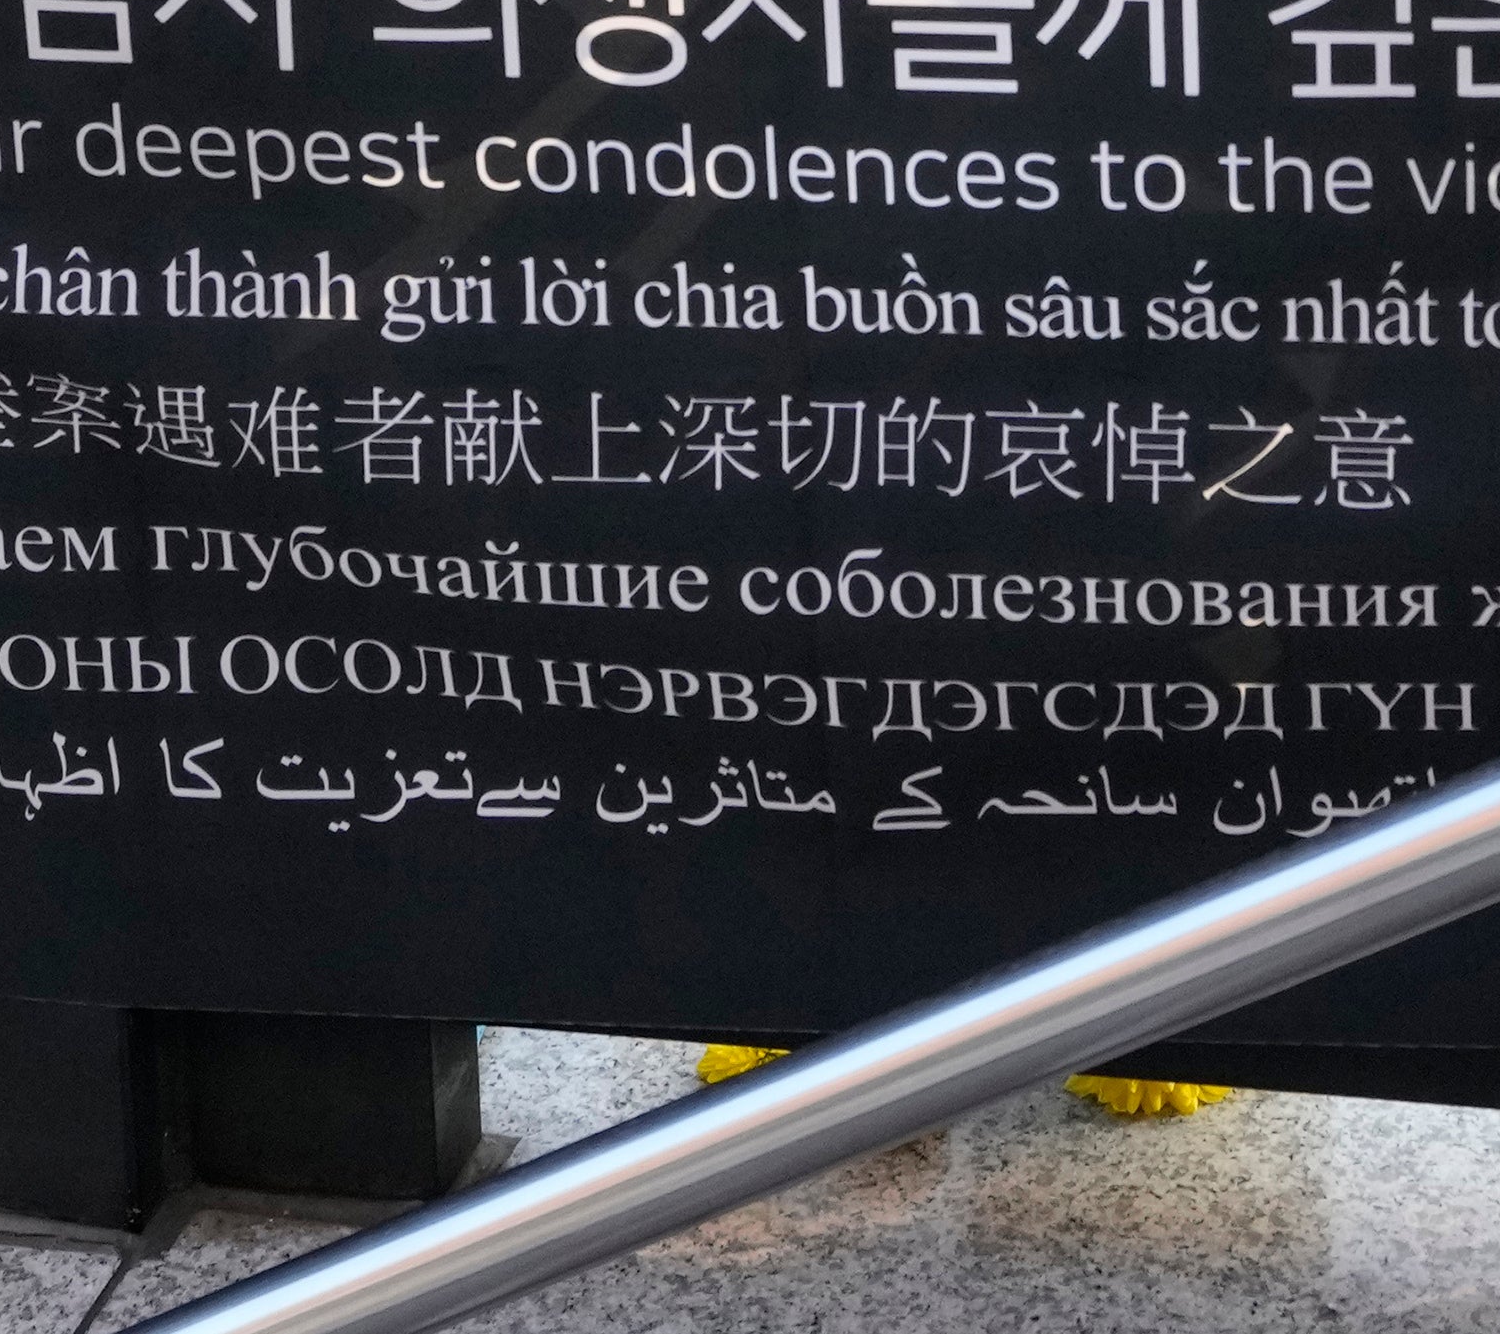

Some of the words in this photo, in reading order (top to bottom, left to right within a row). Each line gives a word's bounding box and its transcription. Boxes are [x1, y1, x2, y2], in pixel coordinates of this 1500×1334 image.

[75, 101, 448, 203] deepest
[475, 122, 1062, 207] condolences
[1089, 140, 1189, 215] to
[1217, 135, 1376, 217] the
[161, 247, 363, 323] thành
[380, 255, 499, 345] gửi
[519, 256, 613, 329] lời
[633, 260, 786, 333] chia
[798, 252, 986, 338] buồn
[1004, 275, 1127, 343] sâu
[1146, 258, 1263, 344] sắc
[1282, 260, 1441, 349] nhất
[150, 525, 711, 615] глубочайшие
[739, 547, 1440, 630] соболезнования
[219, 634, 525, 716] ОСОЛД
[539, 659, 1286, 743] НЭРВЭГДЭГСДЭД
[1307, 683, 1476, 733] ГҮН
